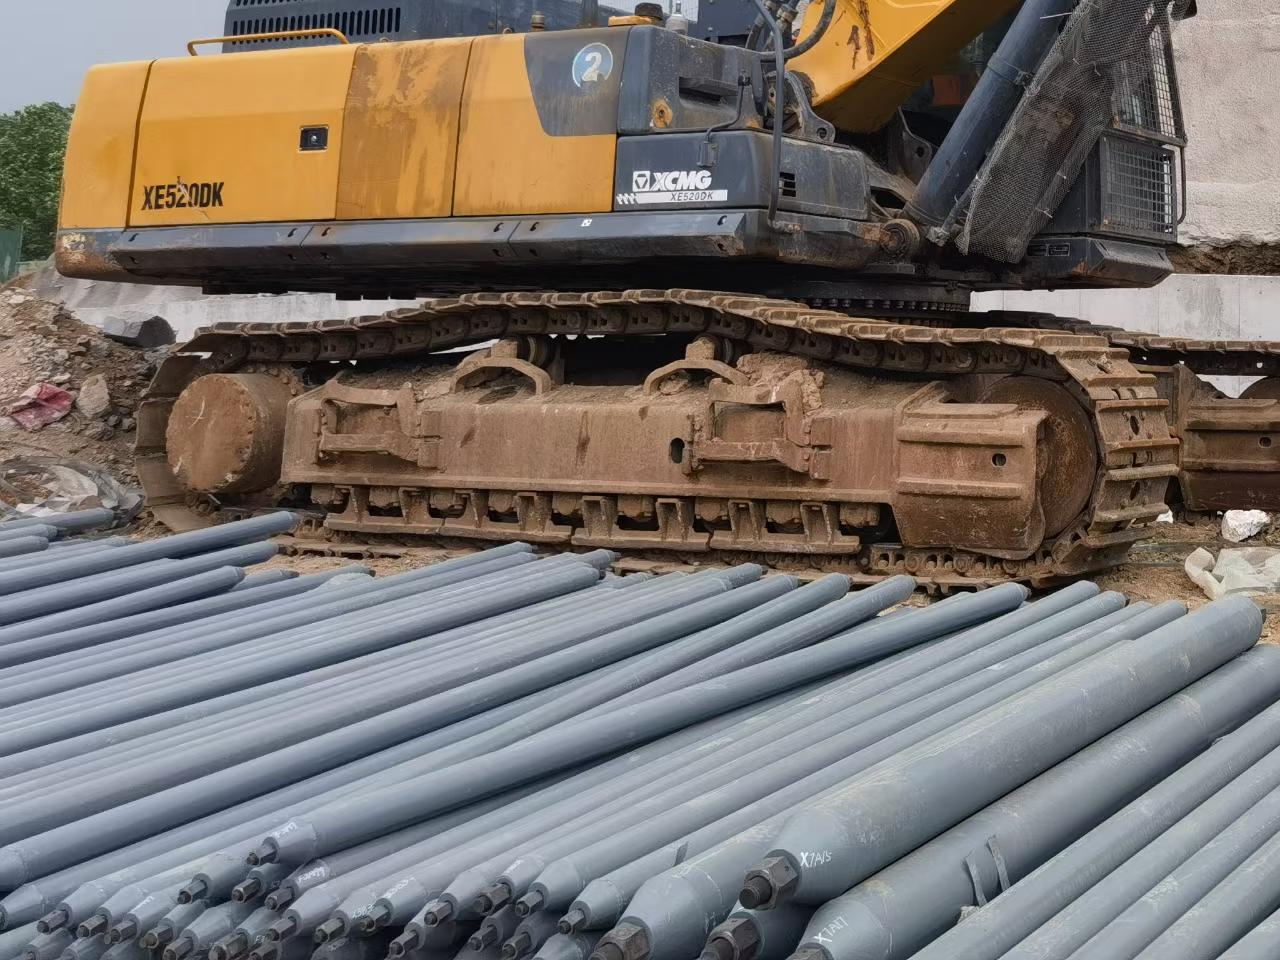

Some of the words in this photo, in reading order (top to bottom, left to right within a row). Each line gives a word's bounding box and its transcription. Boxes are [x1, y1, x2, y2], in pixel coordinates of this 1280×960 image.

[581, 51, 602, 82] 2
[650, 169, 712, 191] XCMG
[141, 182, 225, 210] XE520DK
[669, 191, 714, 202] XE520DK
